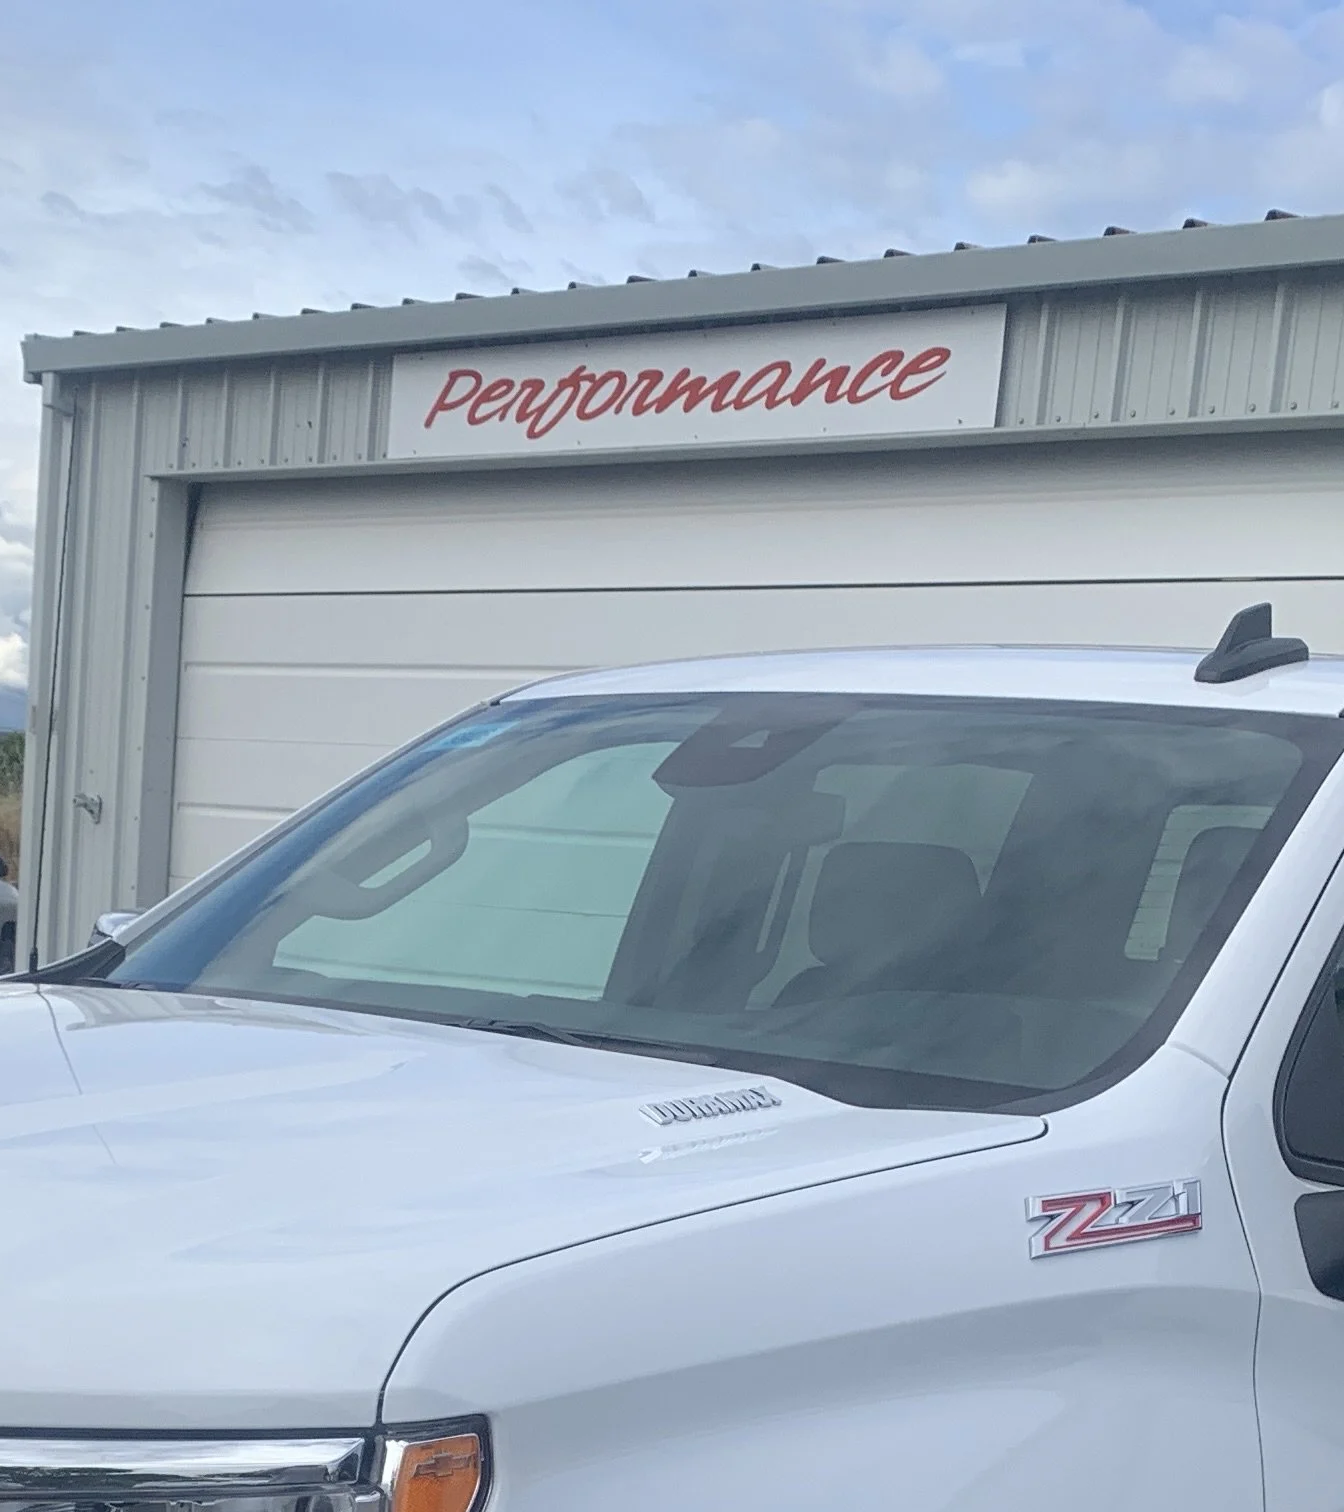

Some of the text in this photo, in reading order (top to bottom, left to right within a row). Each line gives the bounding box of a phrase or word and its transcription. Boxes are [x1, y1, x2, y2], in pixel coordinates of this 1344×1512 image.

[423, 346, 951, 440] Performance
[638, 1085, 783, 1126] DURAMAX
[1024, 1177, 1204, 1260] Z71
